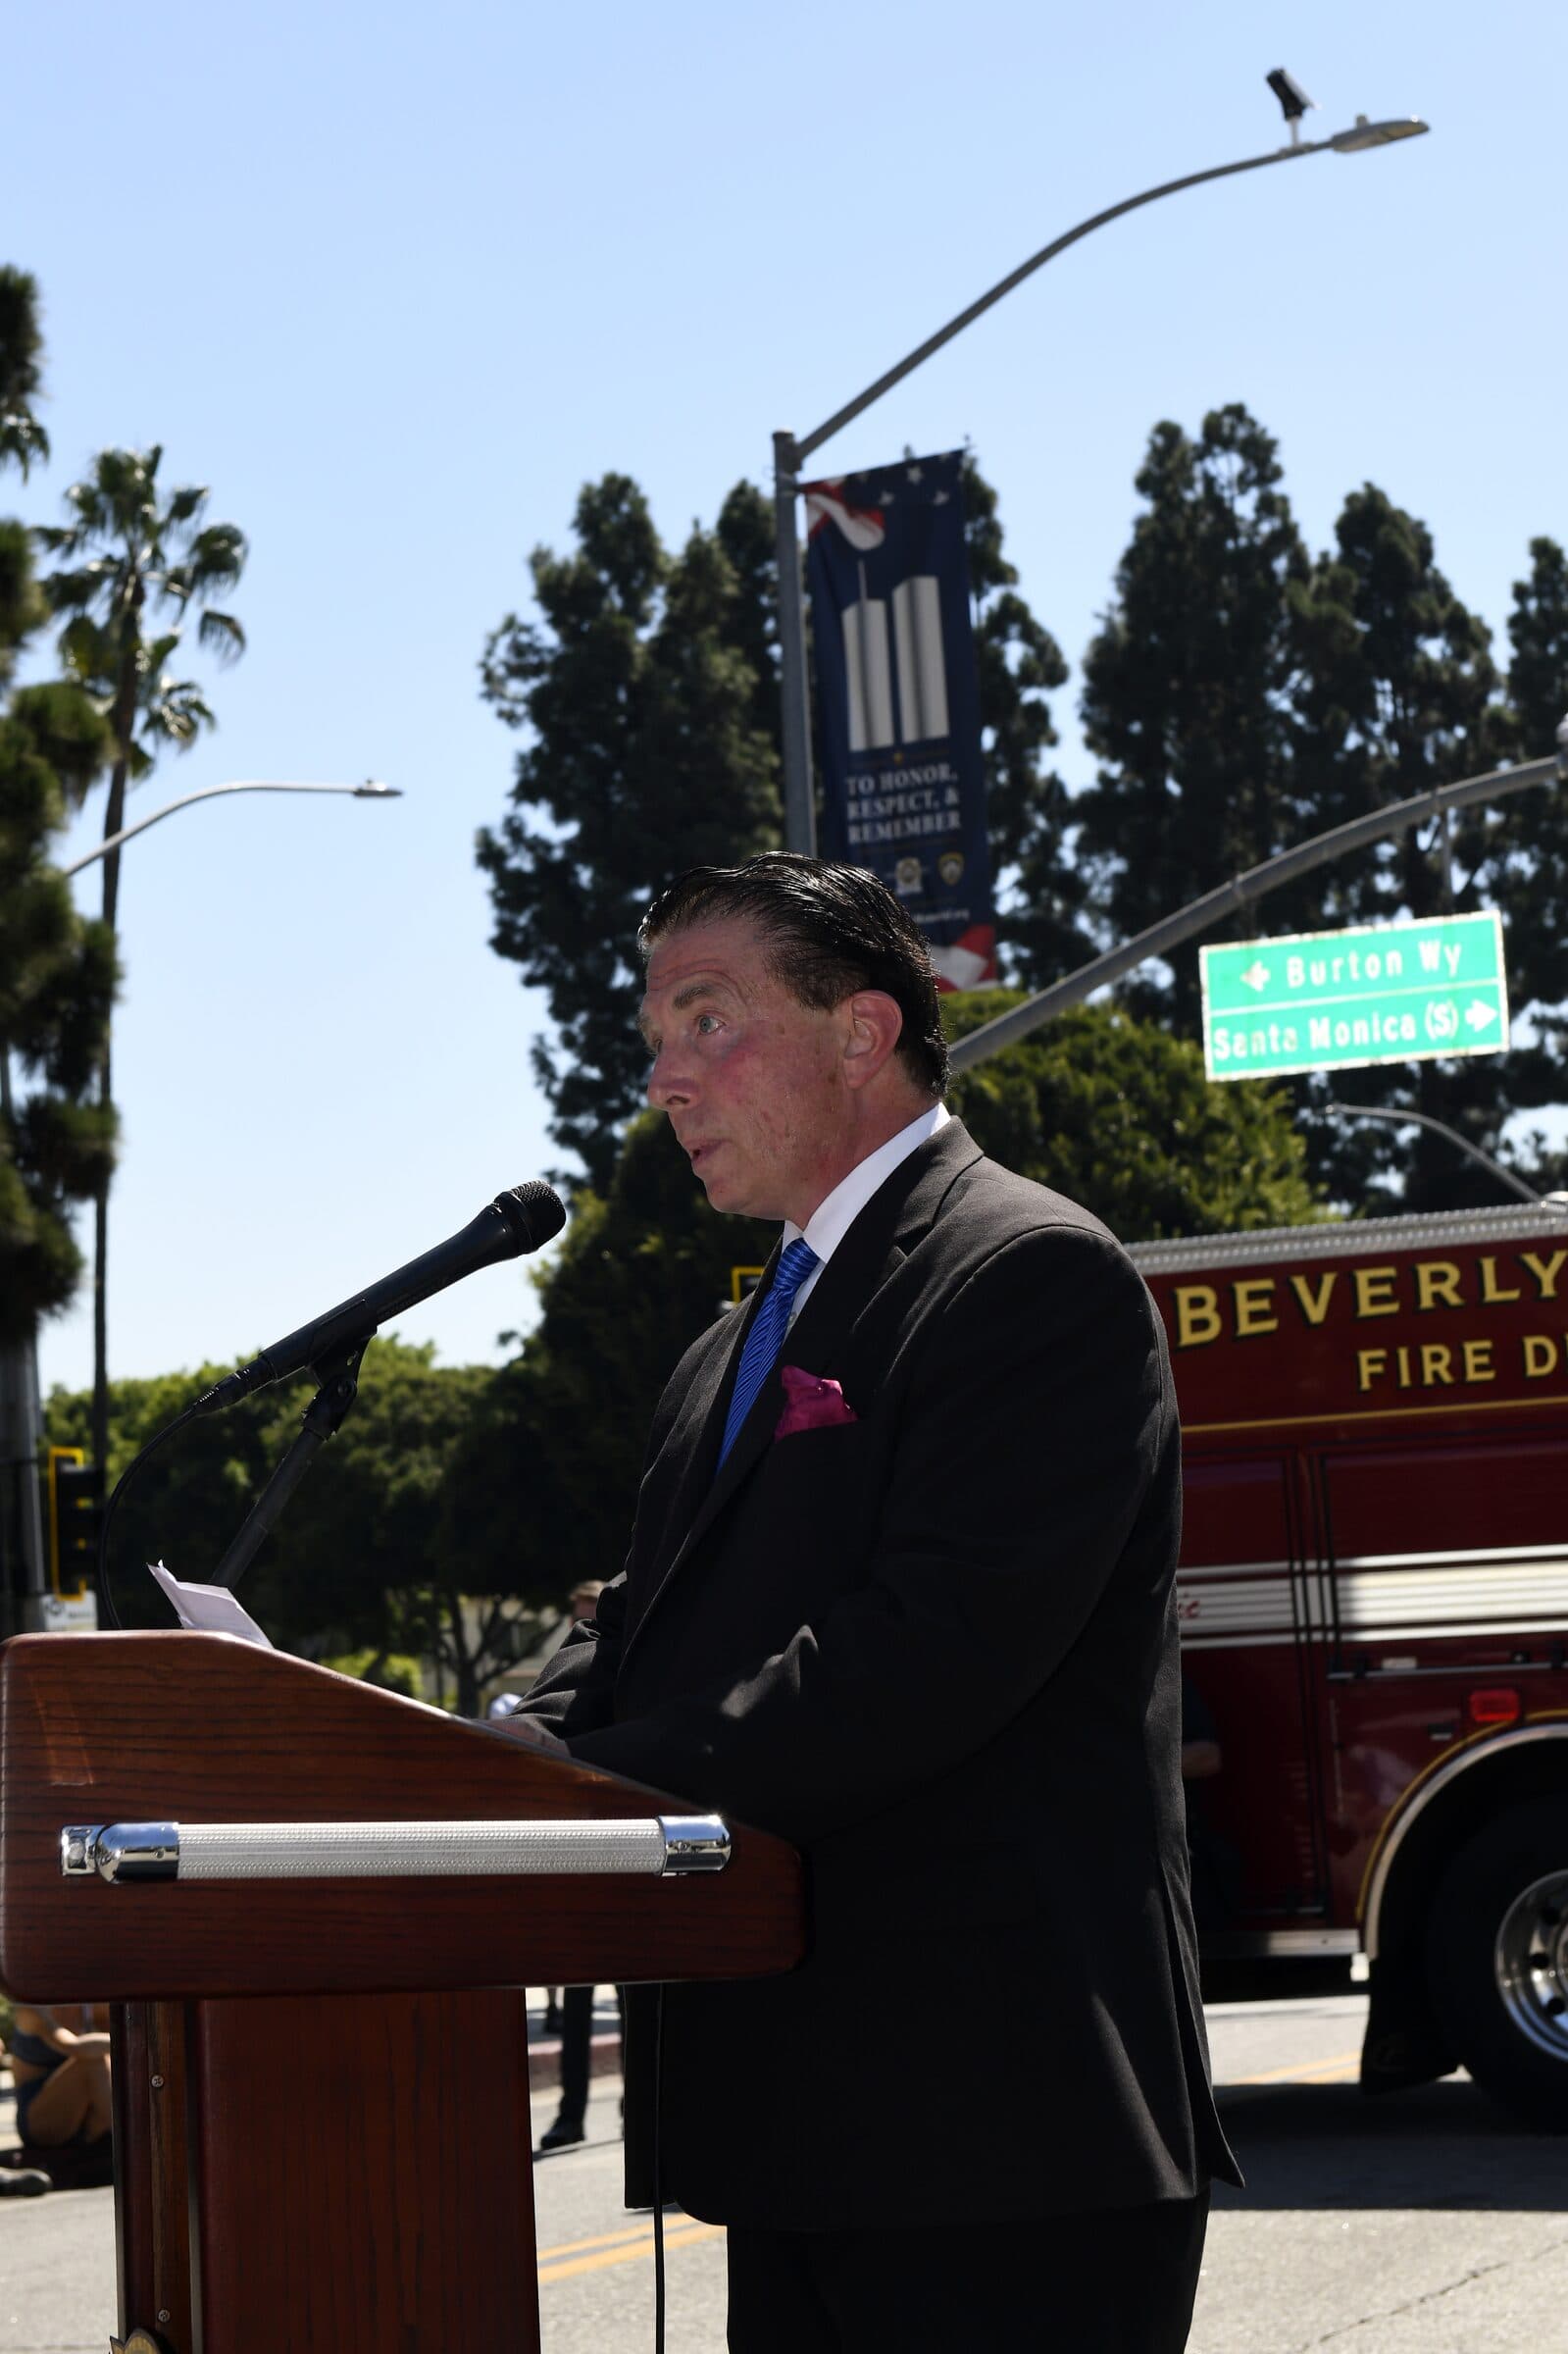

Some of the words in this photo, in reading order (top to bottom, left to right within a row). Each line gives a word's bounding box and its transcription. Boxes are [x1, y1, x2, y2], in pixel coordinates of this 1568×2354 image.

[846, 775, 875, 796] TO
[944, 786, 960, 806] &
[847, 809, 962, 844] REMEMBER
[1286, 948, 1403, 989] Burton
[1418, 939, 1462, 977] Wy
[1212, 1023, 1298, 1060] Santa
[1308, 1012, 1416, 1049] Monica
[1425, 998, 1459, 1040] (S)
[1176, 1249, 1568, 1348] BEVERLY
[1357, 1340, 1496, 1391] FIRE
[1522, 1333, 1568, 1378] D
